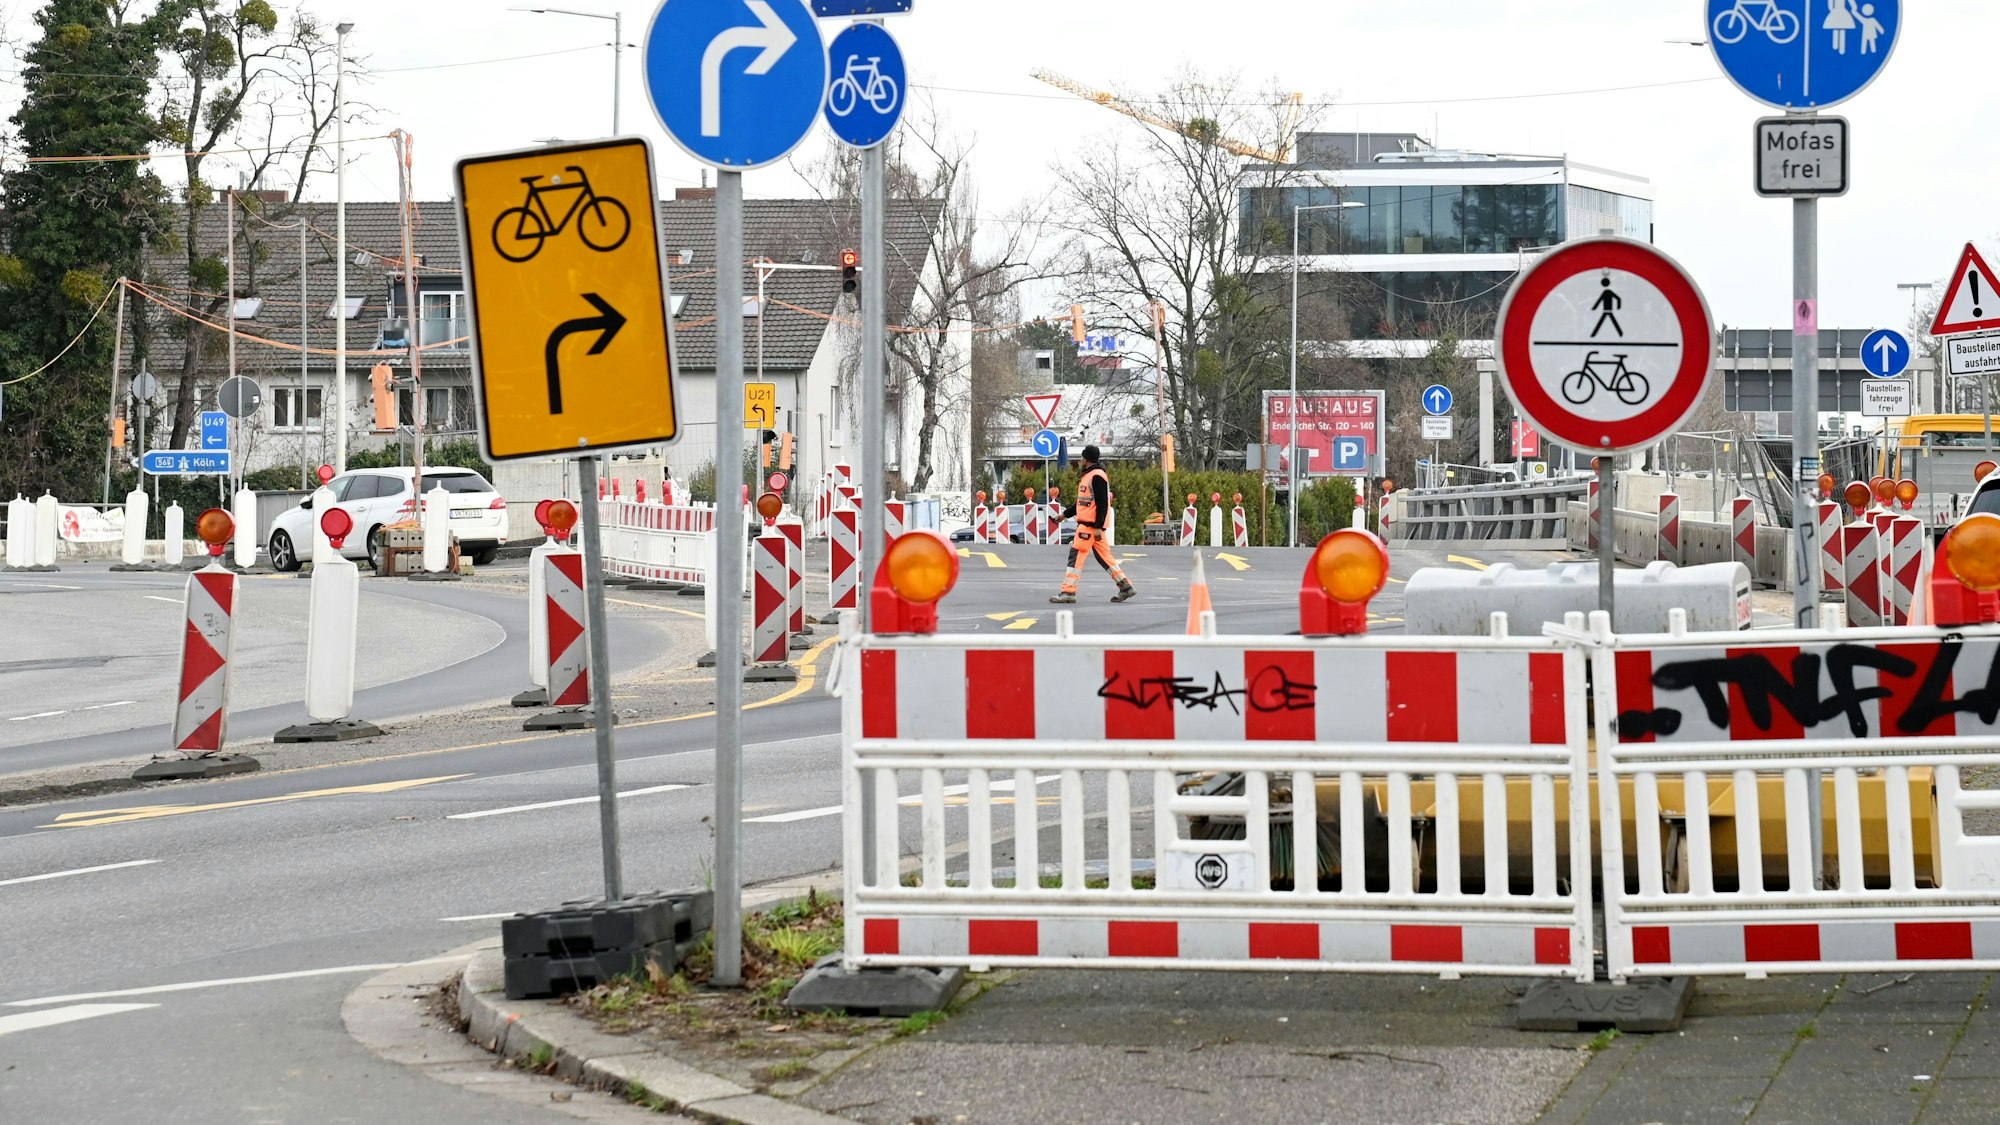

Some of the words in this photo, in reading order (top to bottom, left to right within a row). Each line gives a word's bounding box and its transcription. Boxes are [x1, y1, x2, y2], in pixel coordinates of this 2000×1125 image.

[1767, 131, 1835, 151] Mofas
[1781, 159, 1821, 179] frei
[1866, 384, 1905, 392] Baustellen-
[748, 389, 770, 400] U21
[1869, 394, 1903, 404] fahrzeuge
[1878, 404, 1894, 412] frei
[213, 418, 224, 426] 49
[1318, 421, 1332, 431] Str.
[1335, 421, 1350, 431] 120
[1360, 421, 1374, 431] 140
[1340, 441, 1359, 464] P
[193, 458, 214, 466] Köln
[1201, 865, 1222, 877] AVS
[1552, 994, 1643, 1015] AVS
